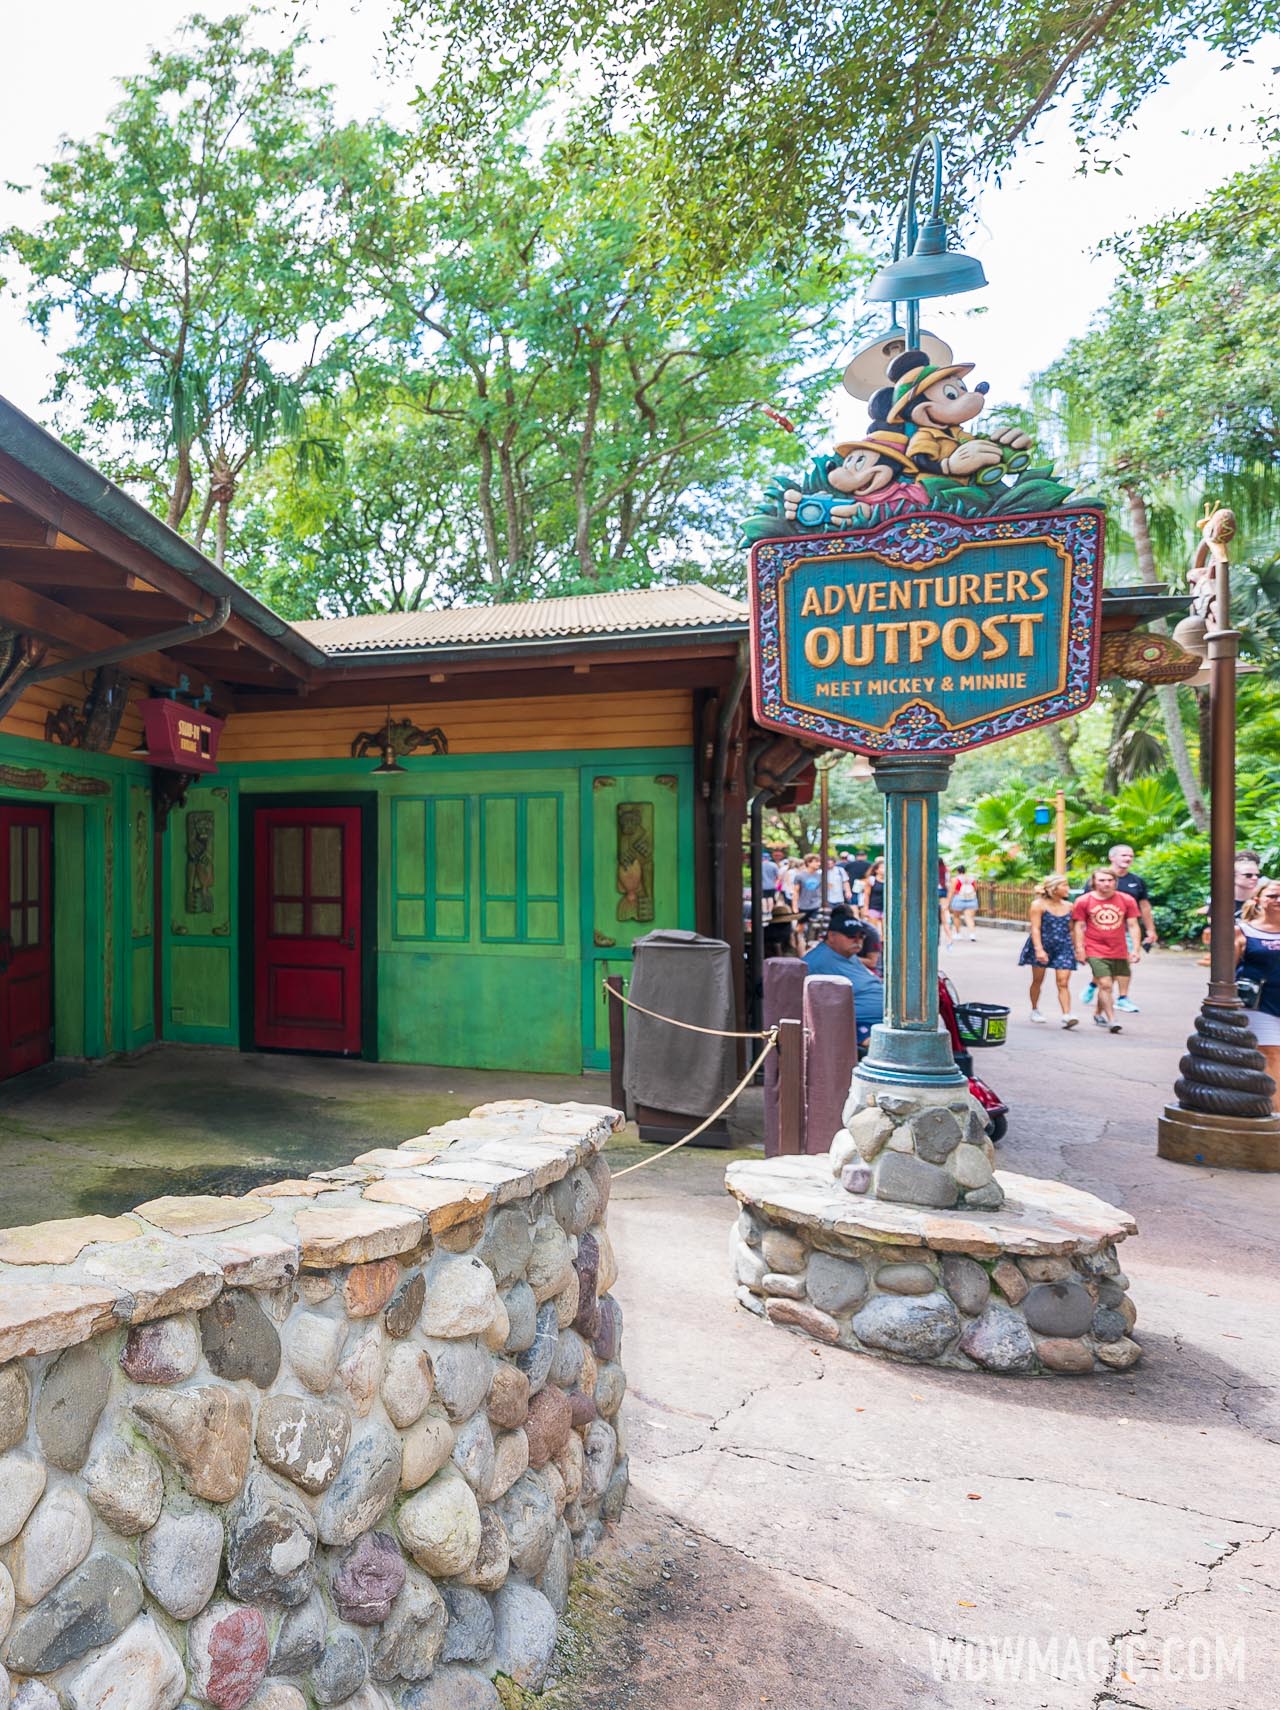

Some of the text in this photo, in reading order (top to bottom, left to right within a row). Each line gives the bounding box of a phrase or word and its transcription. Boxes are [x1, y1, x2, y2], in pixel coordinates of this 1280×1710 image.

[800, 568, 1050, 617] ADVENTURERS
[804, 613, 1045, 668] OUTPOST
[815, 673, 1028, 697] MEET MICKEY & MINNIE
